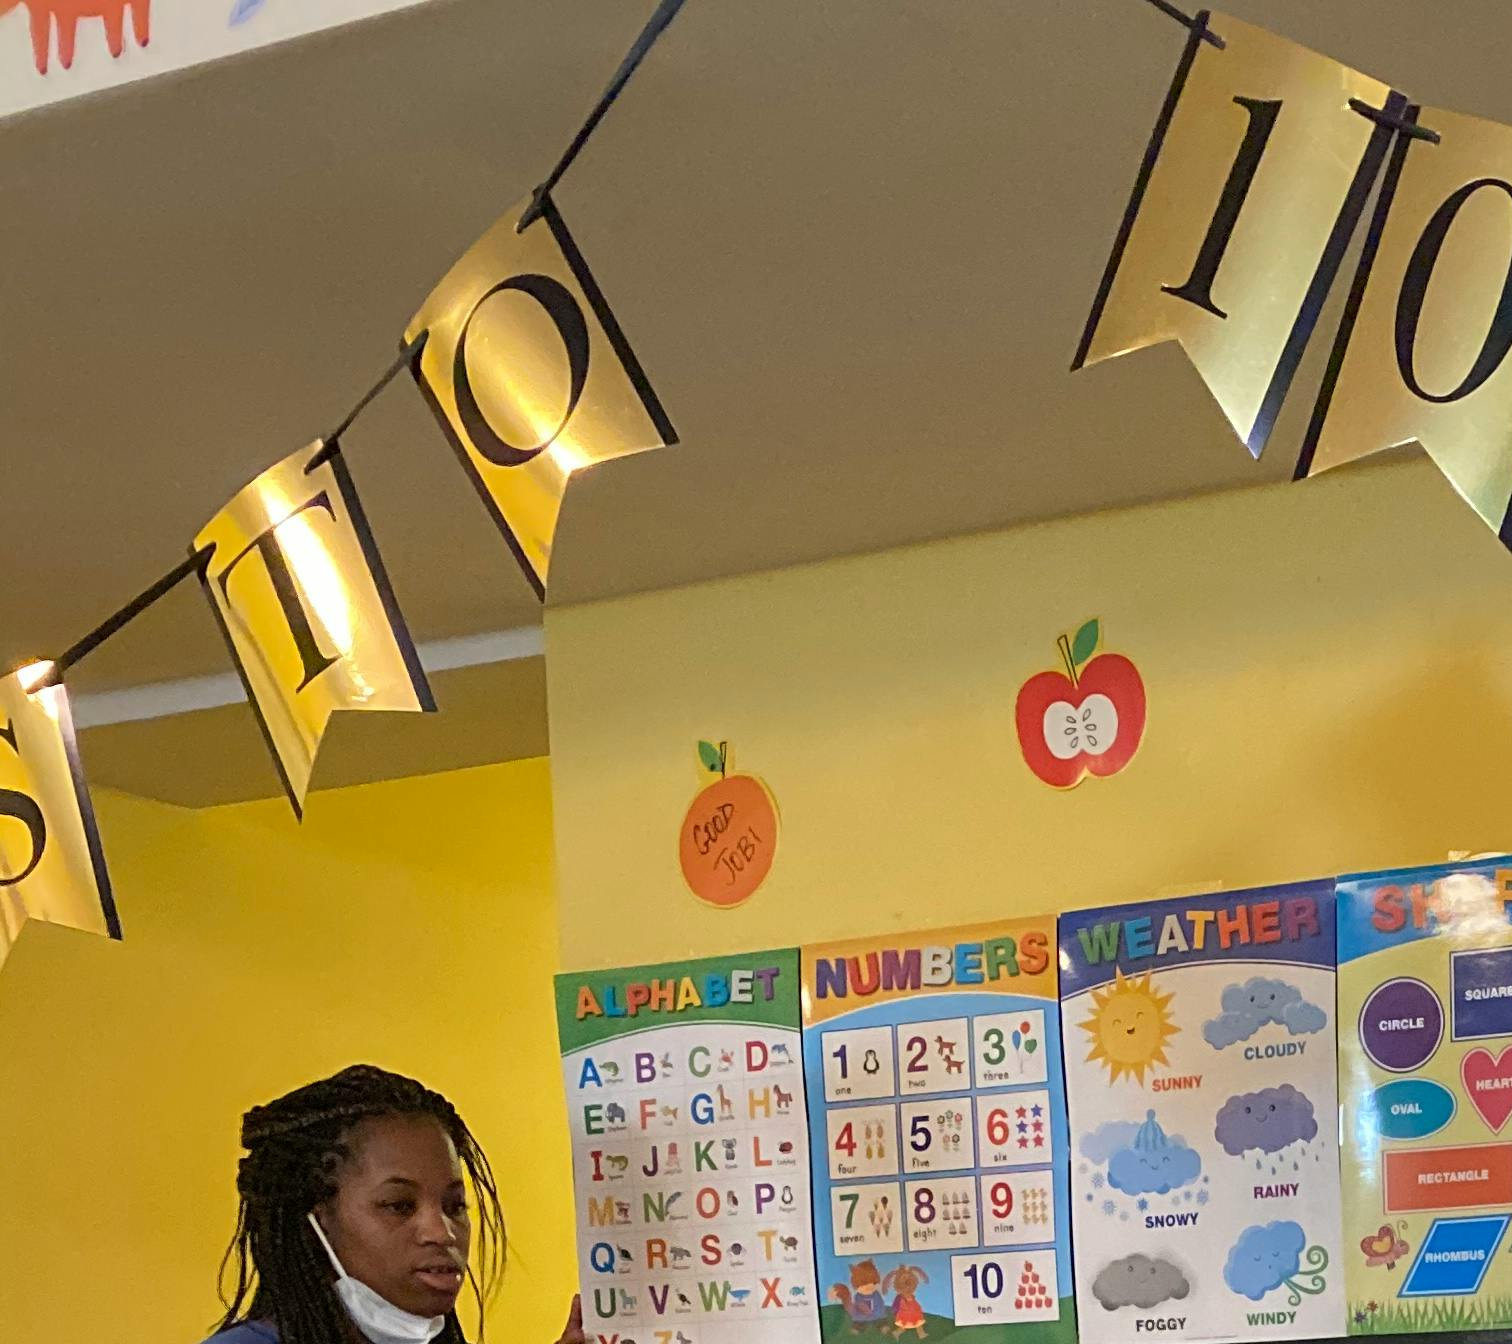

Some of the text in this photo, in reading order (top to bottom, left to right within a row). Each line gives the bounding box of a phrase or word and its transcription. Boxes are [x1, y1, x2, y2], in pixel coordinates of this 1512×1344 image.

[693, 803, 735, 855] GOOD
[1077, 897, 1321, 966] WEATHER
[816, 932, 1048, 999] NUMBERS
[575, 967, 779, 1020] ALPHABET
[1378, 1018, 1424, 1031] CIRCLE
[746, 1041, 768, 1072] D
[833, 1045, 848, 1079] 1
[906, 1036, 928, 1073] 2
[983, 1028, 1006, 1065] 3
[1245, 1042, 1306, 1060] CLOUDY
[579, 1057, 603, 1089] A
[635, 1053, 656, 1083] B
[689, 1047, 711, 1078] C
[1152, 1076, 1202, 1091] SUNNY
[640, 1099, 656, 1130] F
[691, 1093, 714, 1125] G
[748, 1088, 770, 1119] H
[1391, 1104, 1422, 1115] OVAL
[584, 1104, 604, 1135] E
[910, 1116, 932, 1152] 5
[987, 1109, 1009, 1145] 6
[754, 1136, 772, 1167] L
[835, 1122, 857, 1157] 4
[694, 1140, 718, 1172] K
[838, 1165, 856, 1174] four
[1253, 1184, 1299, 1199] RAINY
[1418, 1170, 1489, 1184] RECTANGLE
[643, 1192, 665, 1223] N
[754, 1183, 775, 1214] P
[839, 1194, 859, 1229] 7
[914, 1188, 936, 1223] 8
[991, 1182, 1013, 1219] 9
[913, 1229, 936, 1242] eight
[1145, 1212, 1199, 1228] SNOWY
[591, 1243, 615, 1273] Q
[646, 1239, 668, 1269] R
[701, 1234, 722, 1265] S
[1424, 1250, 1485, 1263] RHOMBUS
[964, 1262, 1003, 1299] 10
[594, 1288, 616, 1318] U
[649, 1284, 669, 1314] V
[698, 1281, 730, 1312] W
[1136, 1318, 1187, 1332] FOGGY
[1247, 1312, 1296, 1327] WINDY
